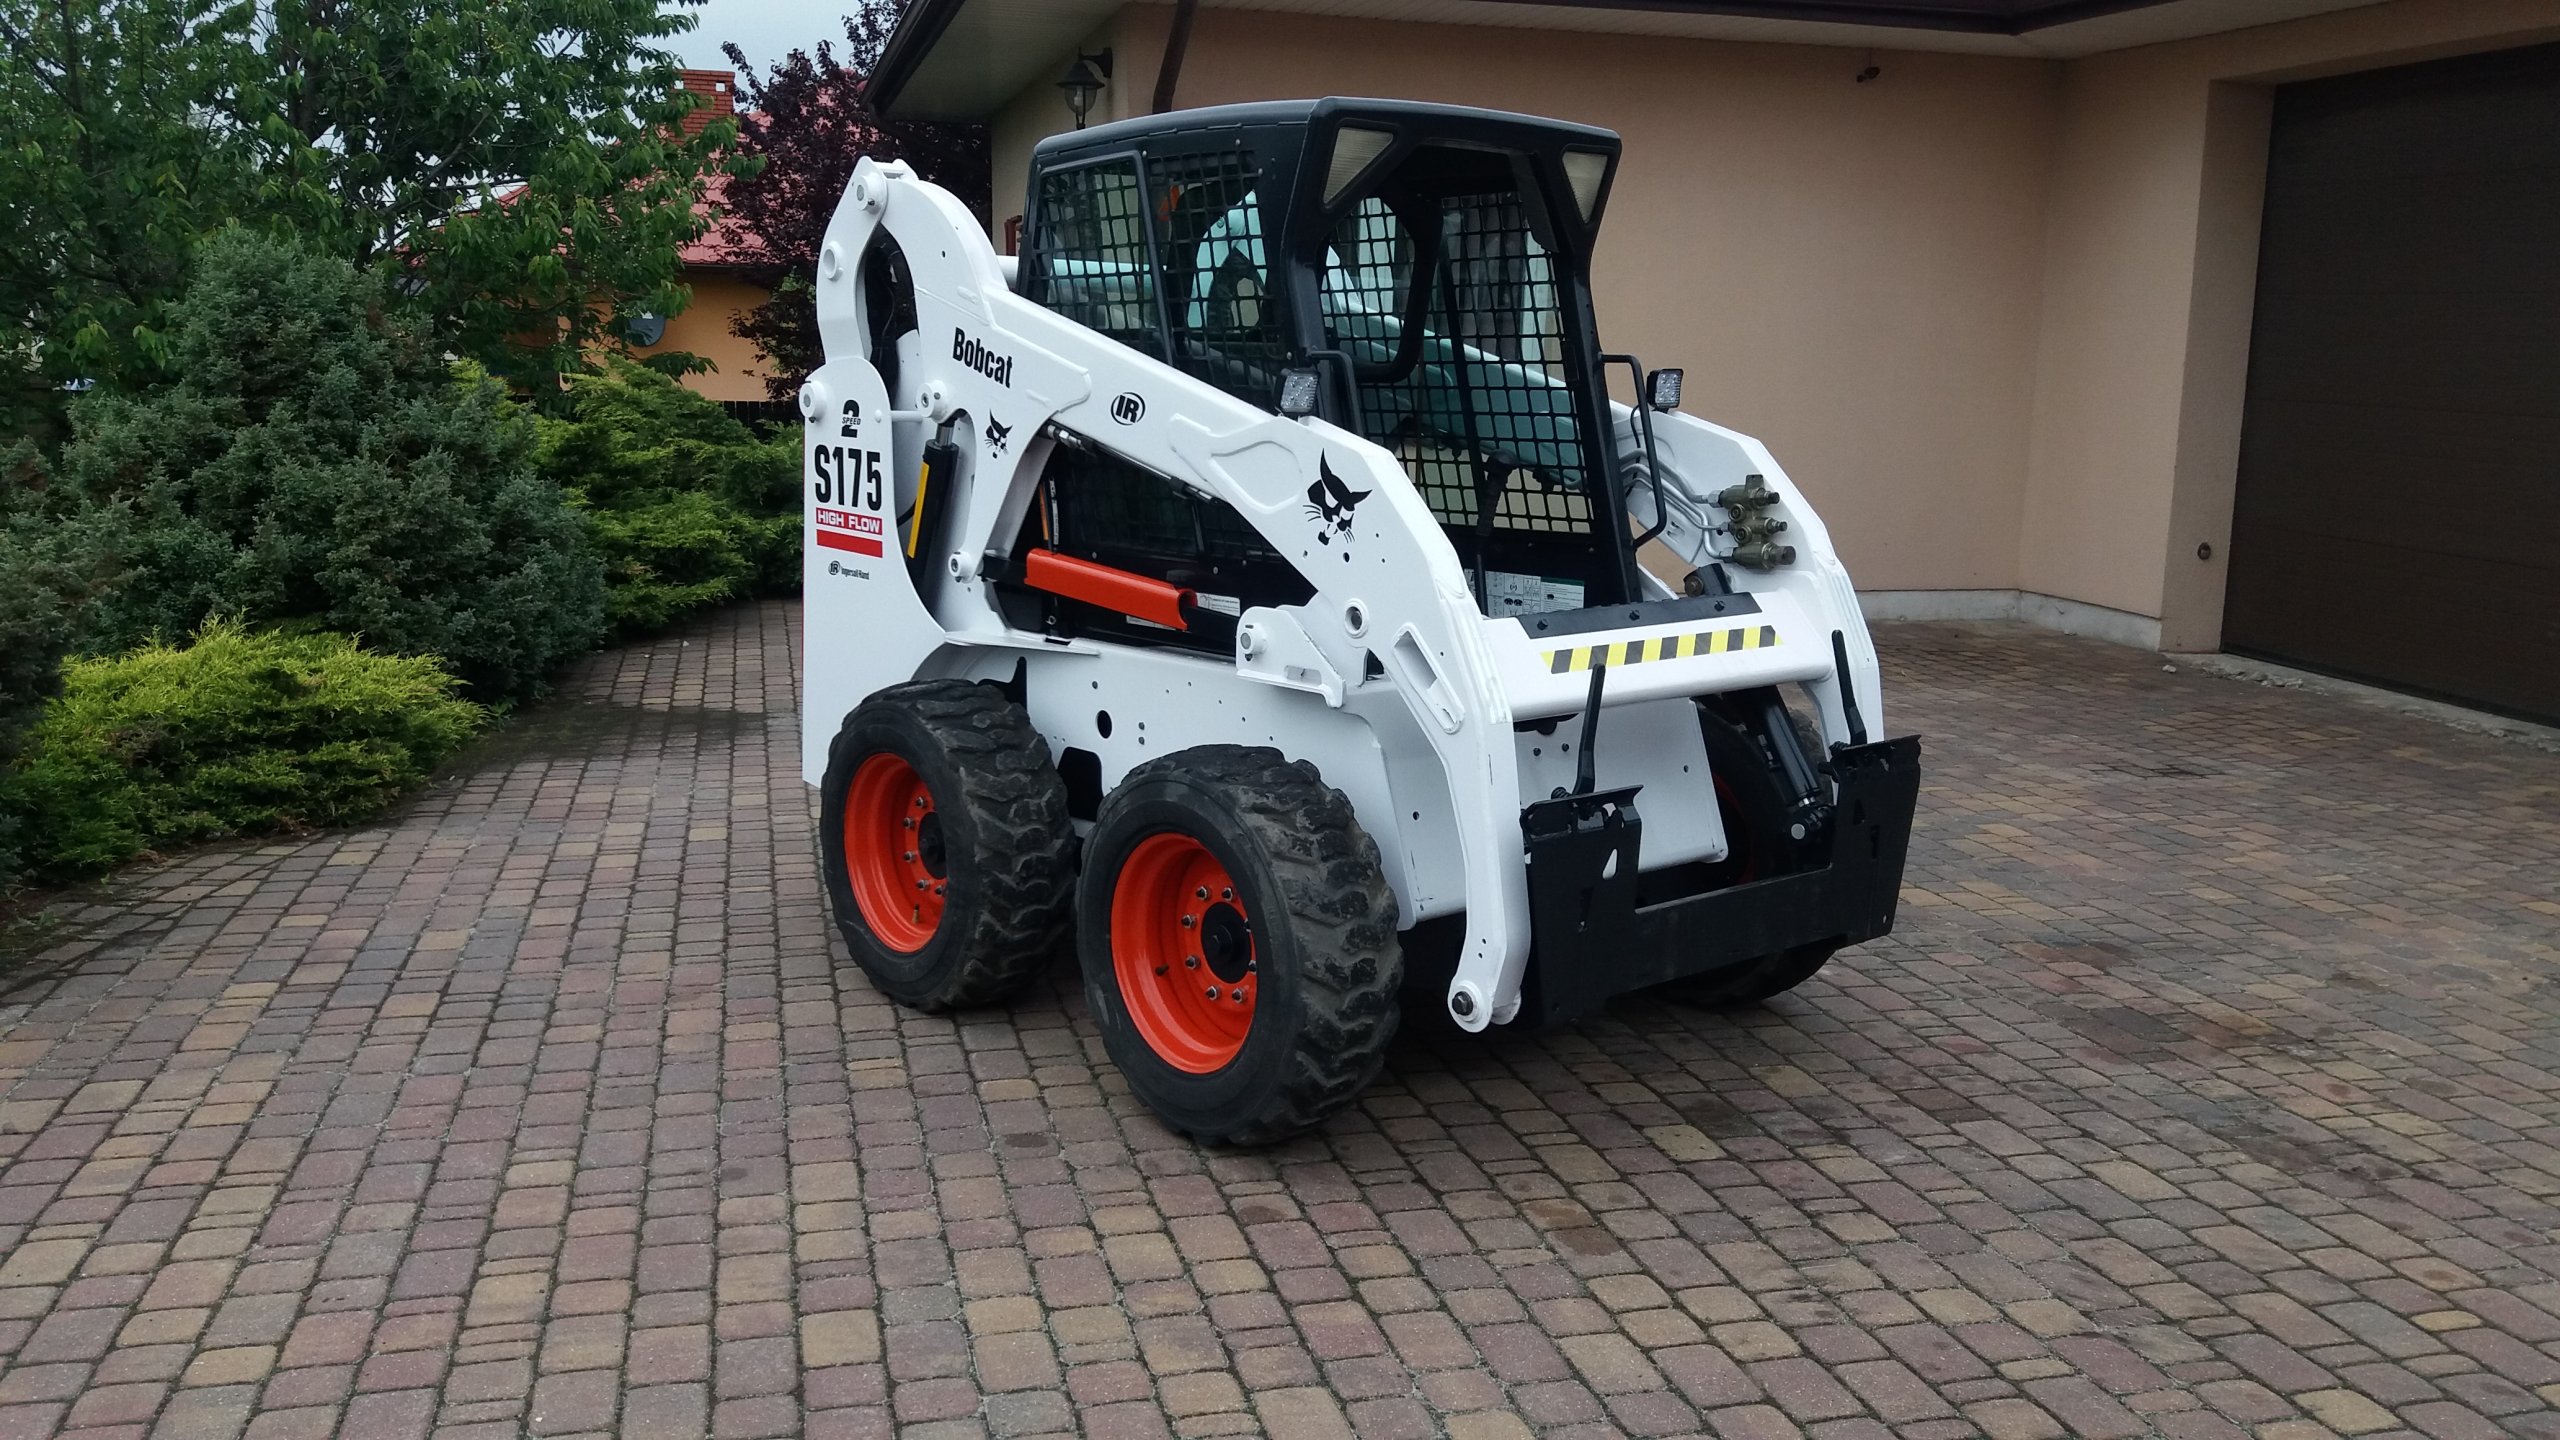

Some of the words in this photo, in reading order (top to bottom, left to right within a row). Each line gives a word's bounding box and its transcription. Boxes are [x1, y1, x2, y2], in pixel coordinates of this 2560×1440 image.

[953, 327, 1013, 388] Bobcat
[841, 399, 860, 438] 2
[841, 416, 862, 426] SPEED
[1115, 394, 1140, 423] IR
[814, 444, 882, 512] S175
[816, 509, 845, 527] HIGH
[847, 515, 881, 533] FLOW
